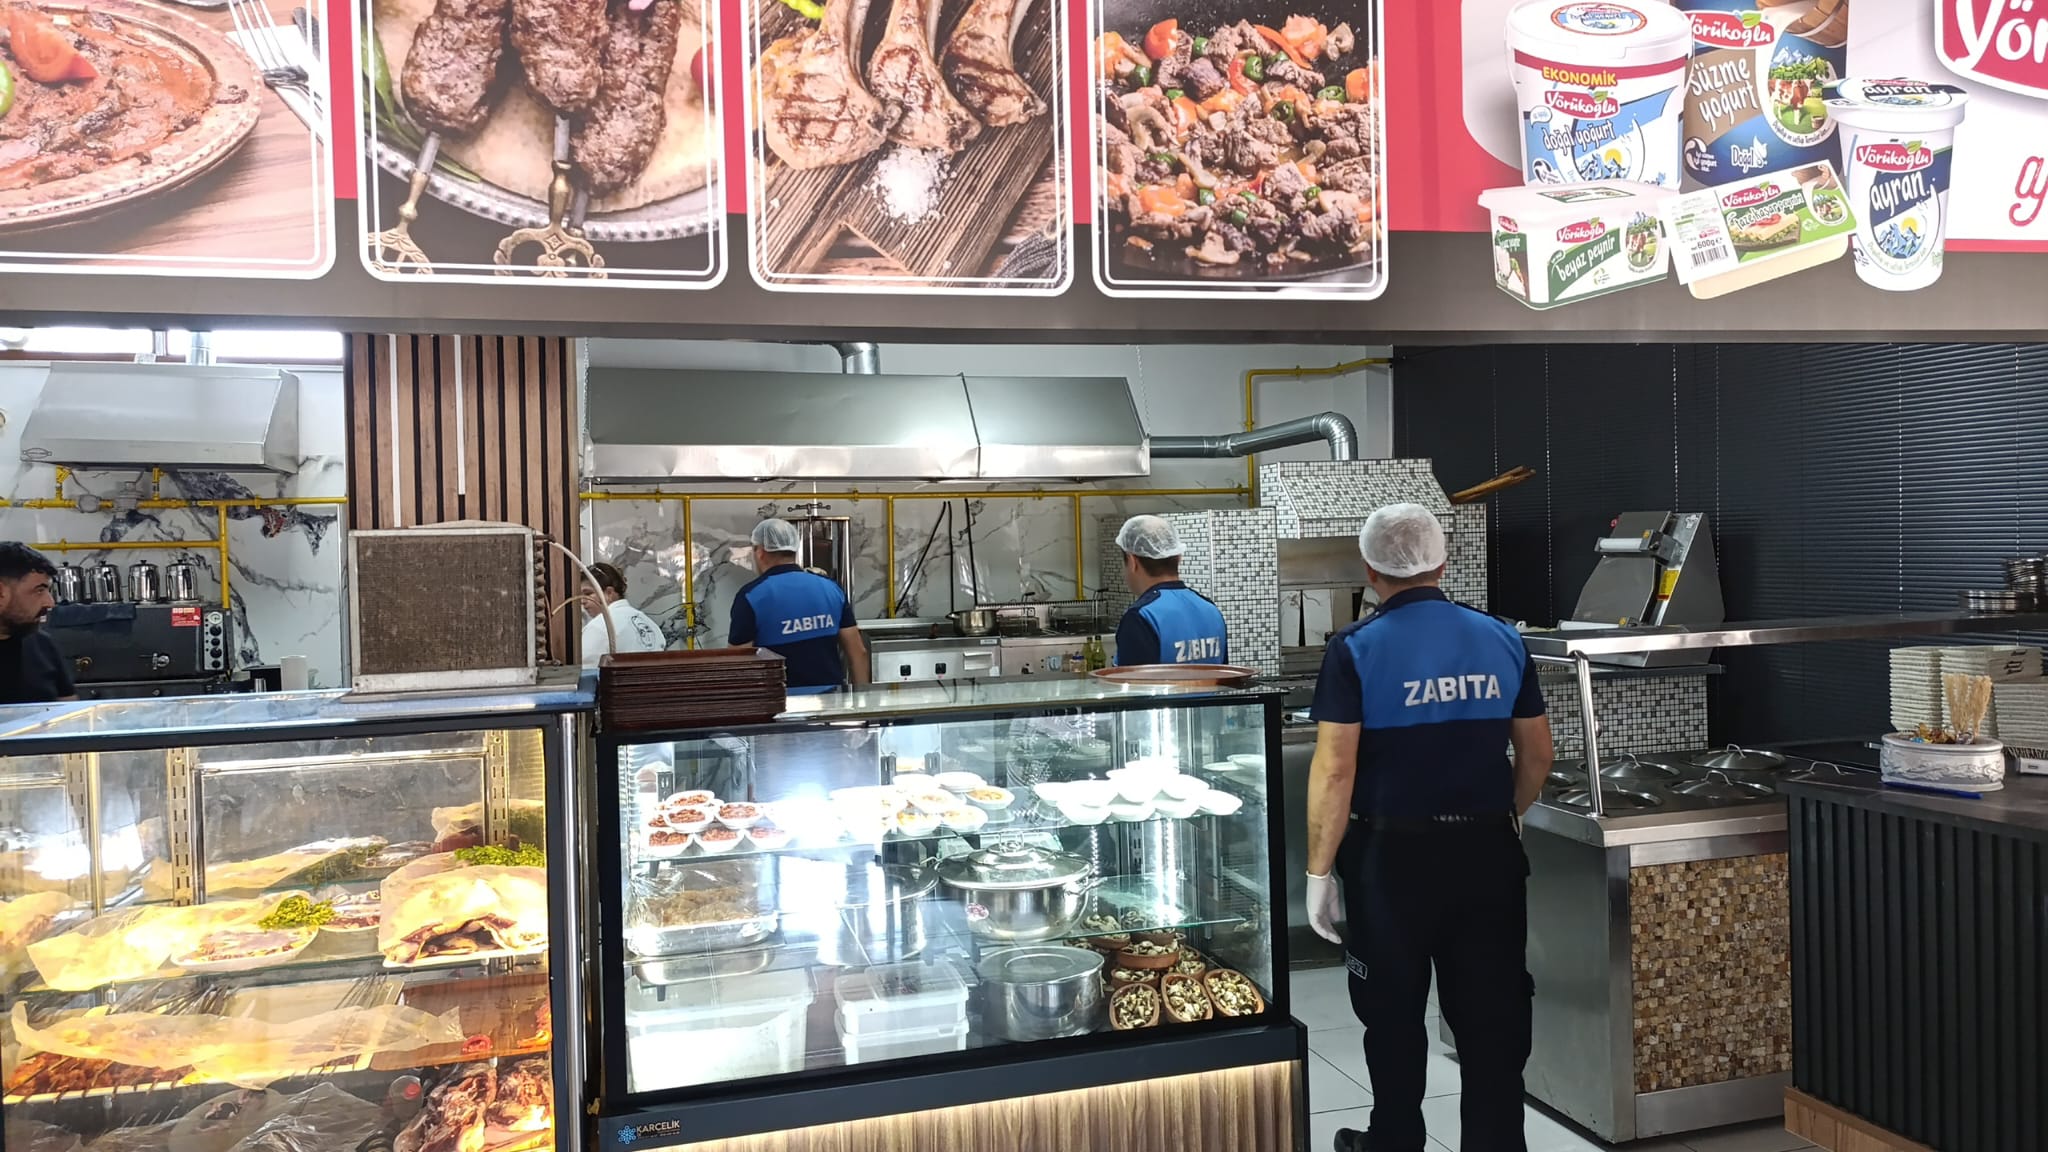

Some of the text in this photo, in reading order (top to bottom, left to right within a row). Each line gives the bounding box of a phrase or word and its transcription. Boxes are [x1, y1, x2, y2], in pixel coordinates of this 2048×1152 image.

[1542, 67, 1617, 86] EKONOMİK
[1690, 58, 1750, 96] süzme
[1699, 81, 1758, 132] yoğurt
[1542, 119, 1616, 156] doğal yoğurt
[1555, 236, 1615, 281] beyaz peynir
[781, 614, 834, 635] ZABITA
[1404, 674, 1500, 707] ZABITA
